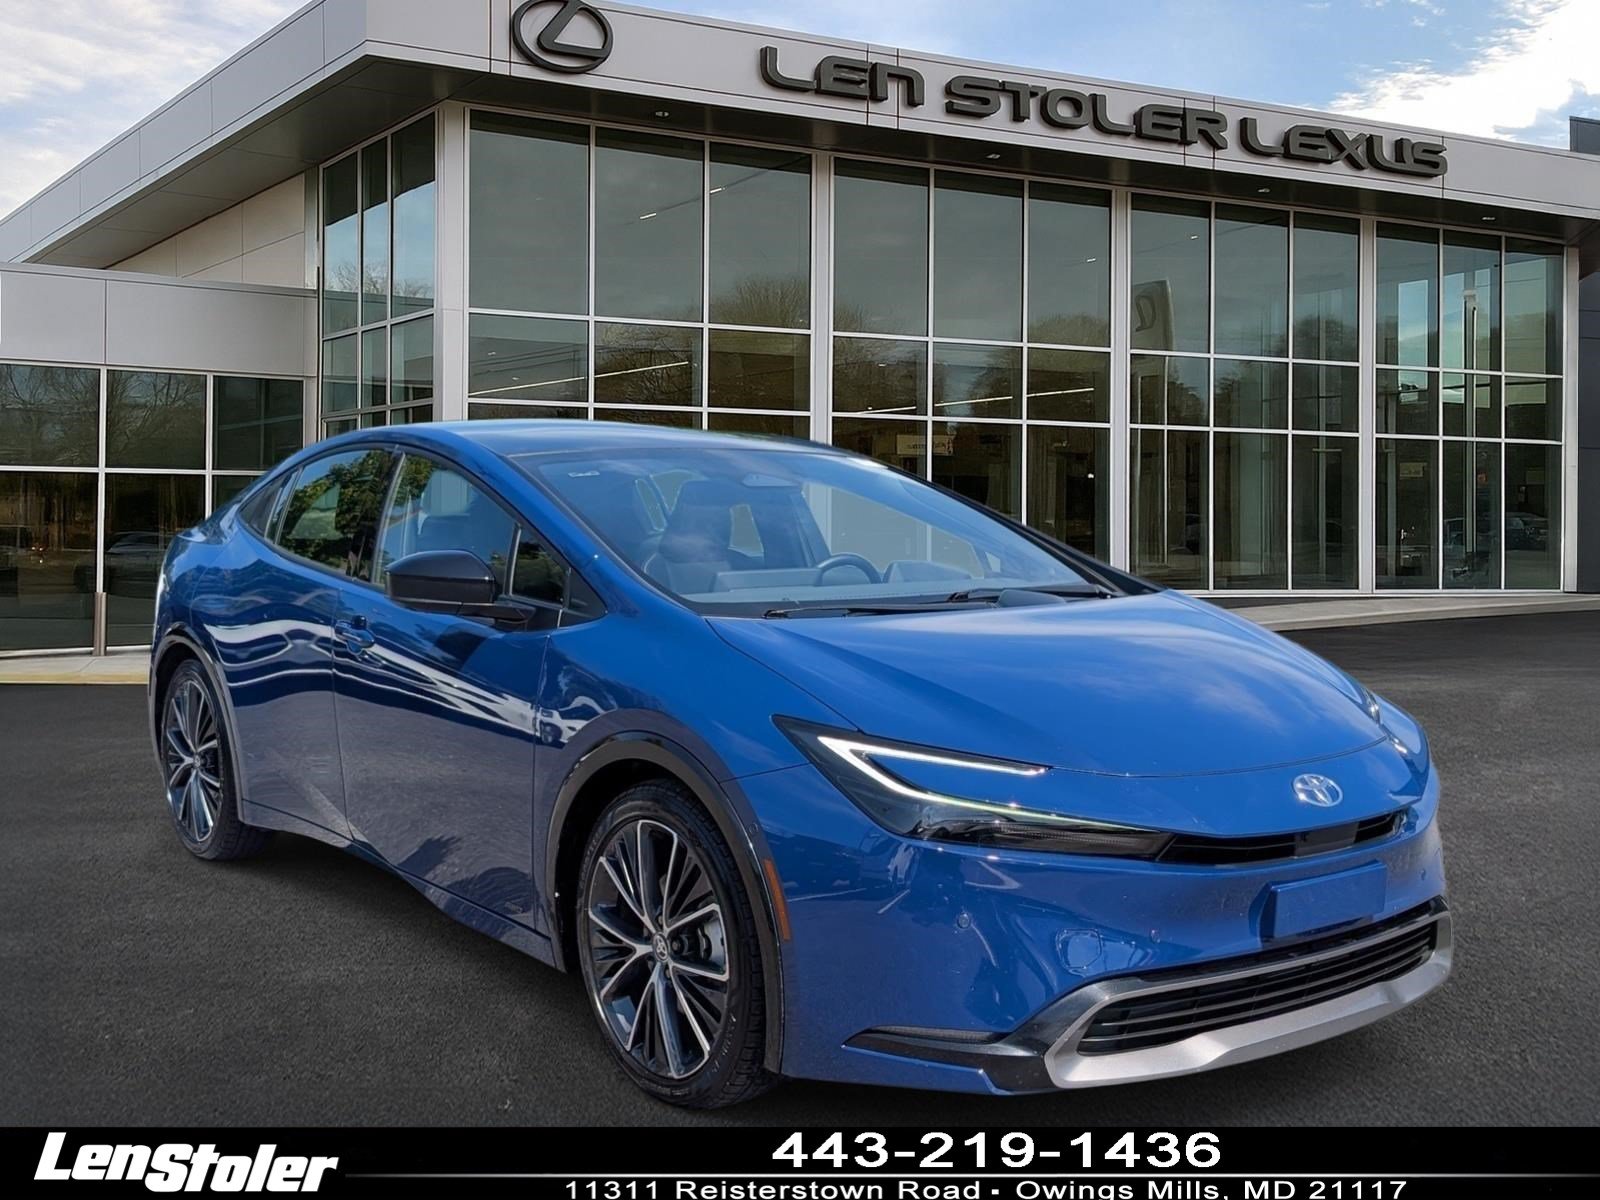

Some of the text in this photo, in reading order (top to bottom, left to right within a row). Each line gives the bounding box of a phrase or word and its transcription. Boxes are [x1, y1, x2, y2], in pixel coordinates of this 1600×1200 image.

[760, 45, 1448, 178] LEN STOLER LEXUS
